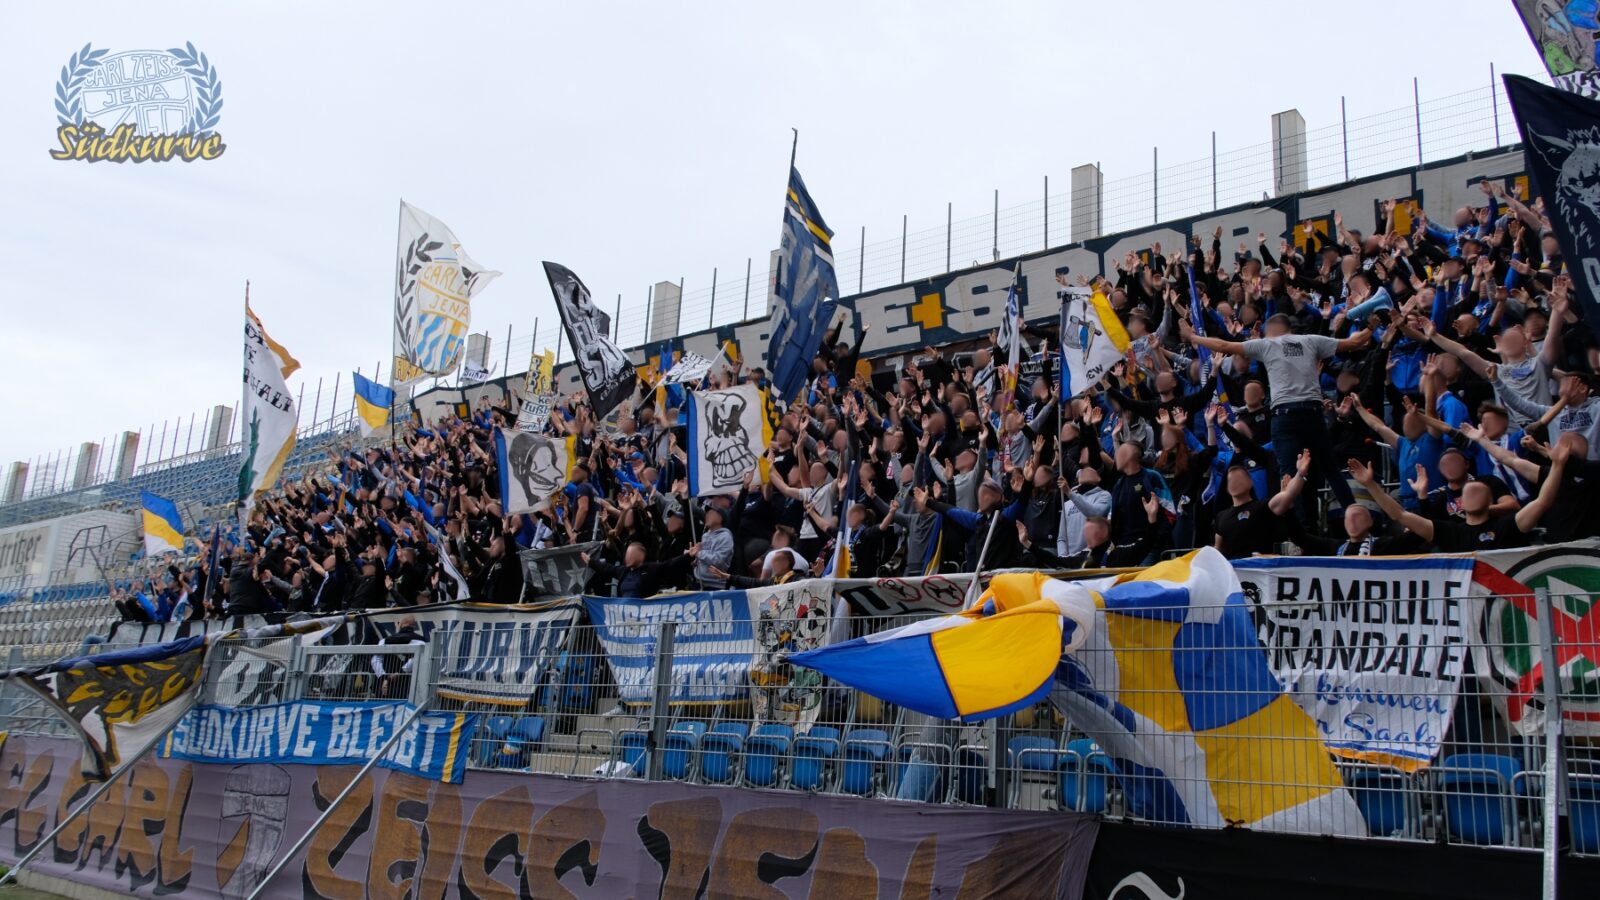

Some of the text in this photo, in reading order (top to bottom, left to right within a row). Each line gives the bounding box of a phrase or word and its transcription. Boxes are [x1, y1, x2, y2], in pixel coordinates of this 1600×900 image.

[1276, 577, 1462, 628] BAMBULE
[1273, 624, 1464, 683] RANDALE
[172, 702, 320, 760] SÜDKURVE
[327, 702, 446, 773] BLEIBT
[1343, 711, 1439, 749] Saale
